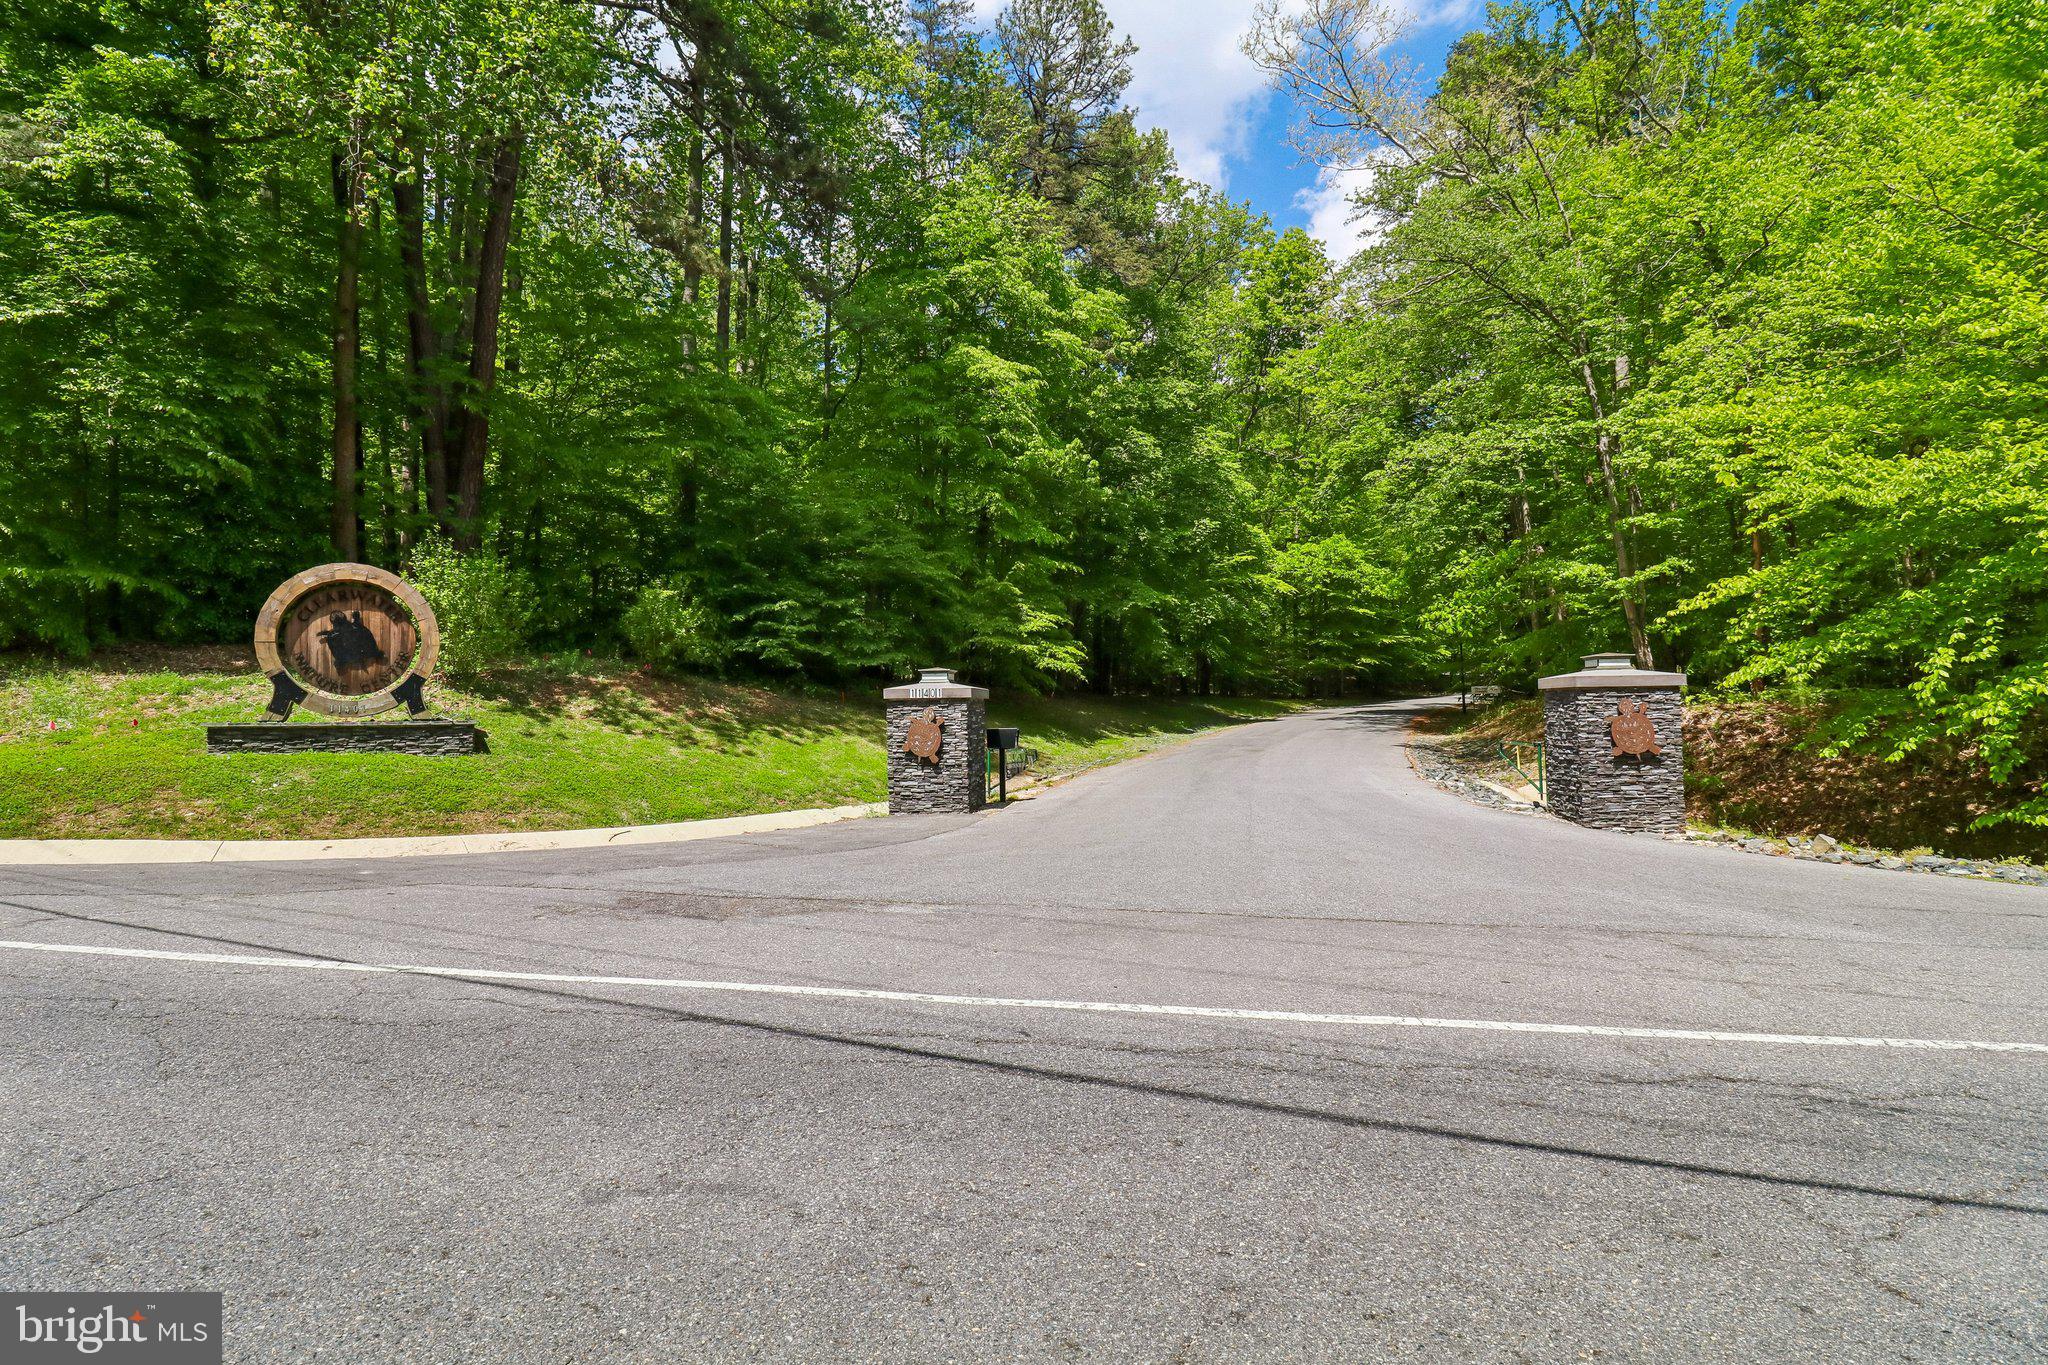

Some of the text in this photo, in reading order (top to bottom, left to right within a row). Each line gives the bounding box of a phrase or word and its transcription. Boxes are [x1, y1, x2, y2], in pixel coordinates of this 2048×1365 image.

[298, 589, 404, 622] CLEARWATER
[294, 651, 410, 694] NATURE CENTER
[910, 688, 942, 698] 11401
